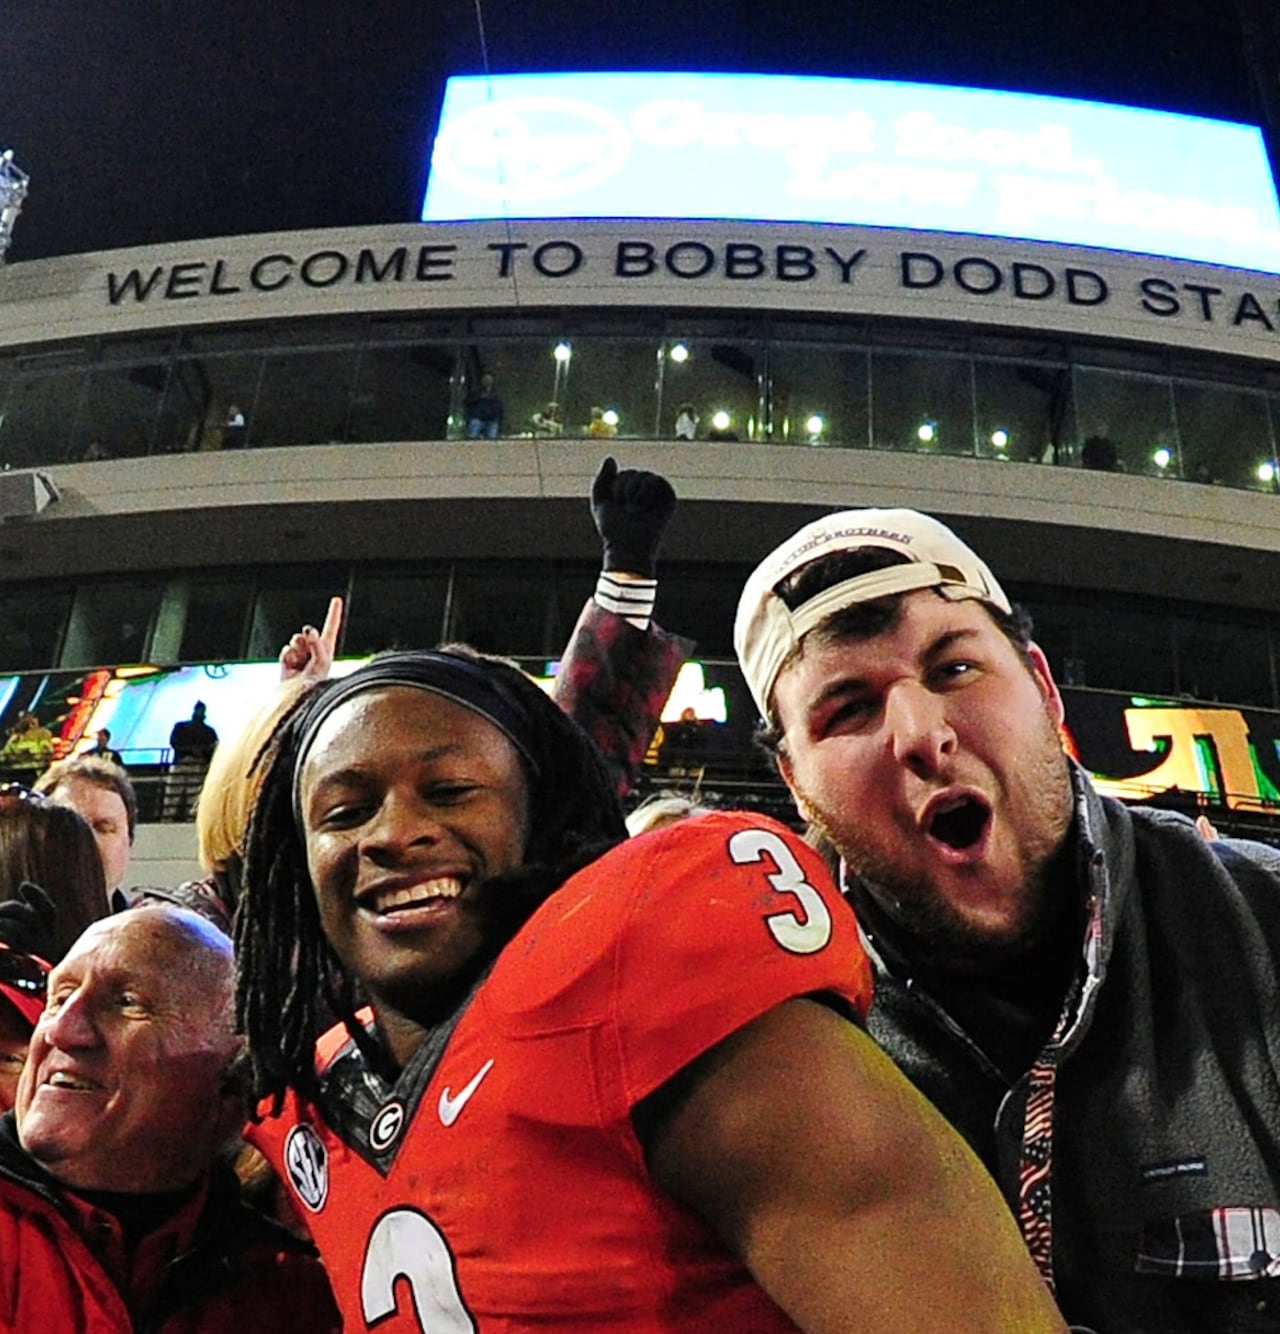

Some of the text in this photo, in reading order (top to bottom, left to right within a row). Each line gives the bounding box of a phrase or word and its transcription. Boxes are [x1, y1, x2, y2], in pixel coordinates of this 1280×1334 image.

[107, 245, 457, 305] WELCOME
[487, 240, 582, 279] TO
[615, 240, 867, 284] BOBBY
[901, 252, 1108, 306] DODD
[730, 829, 831, 954] 3
